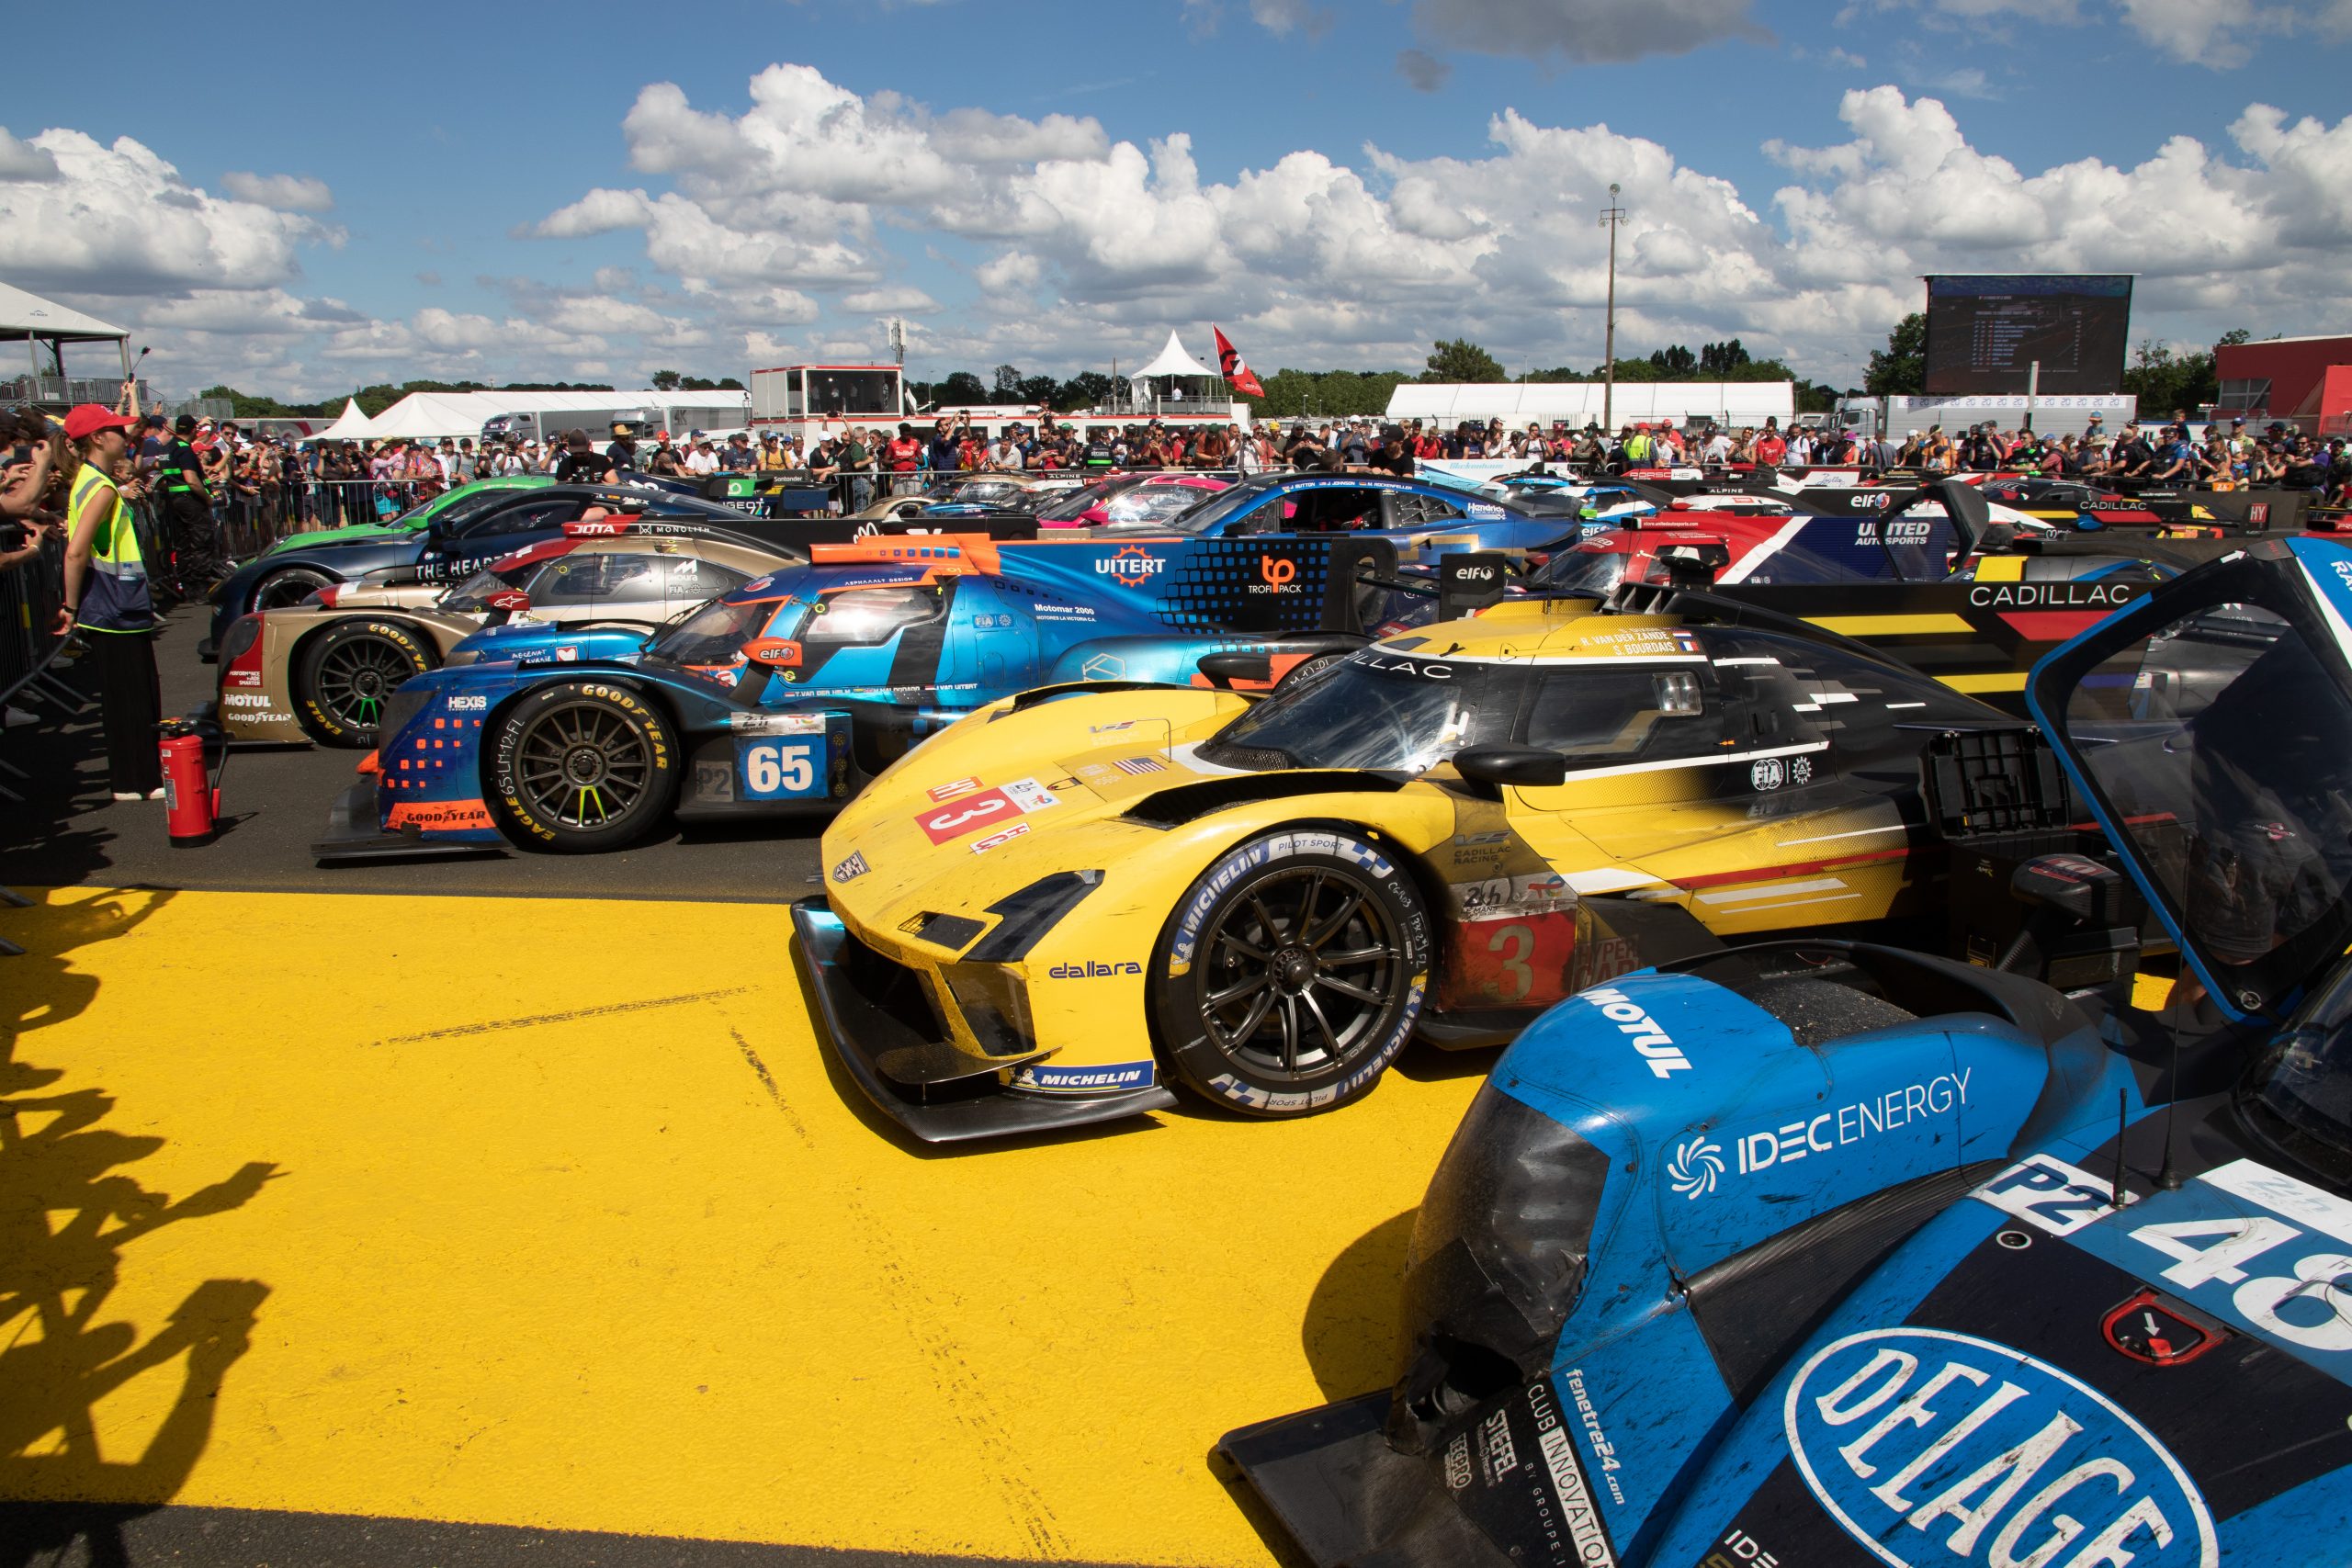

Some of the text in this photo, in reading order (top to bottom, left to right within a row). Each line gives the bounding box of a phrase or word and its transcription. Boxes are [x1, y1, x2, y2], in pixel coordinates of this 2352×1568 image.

[1467, 502, 1505, 513] Hendrick
[1850, 494, 1876, 508] elf
[2080, 502, 2147, 511] CADILLAC
[2249, 505, 2266, 521] HY
[569, 525, 615, 535] JOTA
[1854, 536, 1928, 546] AUTSPORTS
[416, 562, 445, 580] THE
[1095, 558, 1166, 574] UITERT
[1455, 567, 1481, 581] elf
[1249, 584, 1302, 594] TROFI PACK
[1970, 584, 2130, 606] CADILLAC
[1035, 604, 1095, 615] Motomar 2000
[1591, 635, 1612, 645] VAN
[1614, 634, 1634, 643] DER
[1636, 631, 1670, 641] ZANDE
[759, 649, 781, 660] elf
[1623, 642, 1676, 654] BOURDAIS
[224, 694, 272, 707] MOTUL
[447, 695, 487, 708] HEXIS
[228, 711, 292, 724] GOODYEAR
[306, 700, 344, 736] EAGLE
[582, 683, 668, 771] GOODYEAR
[747, 745, 813, 794] 65
[696, 767, 730, 795] P2
[933, 777, 978, 799] HY
[407, 808, 486, 824] GOODYEAR
[505, 796, 557, 841] EAGLE
[929, 797, 1006, 830] 3
[1454, 846, 1511, 858] CADILLAC
[1454, 854, 1498, 865] RACING
[1184, 838, 1344, 938] MICHELIN PILOT SPORT
[1048, 961, 1143, 979] dallara
[1487, 924, 1534, 1002] 3
[1578, 988, 1692, 1079] MOTUL
[1040, 1069, 1142, 1086] MICHELIN
[1838, 1066, 1972, 1145] ENERGY
[1986, 1162, 2113, 1226] P2
[2126, 1216, 2352, 1351] 48
[1566, 1368, 1625, 1506] fenetre24.com
[1449, 1431, 1472, 1489] TECPRO
[1527, 1383, 1610, 1568] CLUB INNOVATIO
[1532, 1487, 1561, 1551] GROUPE
